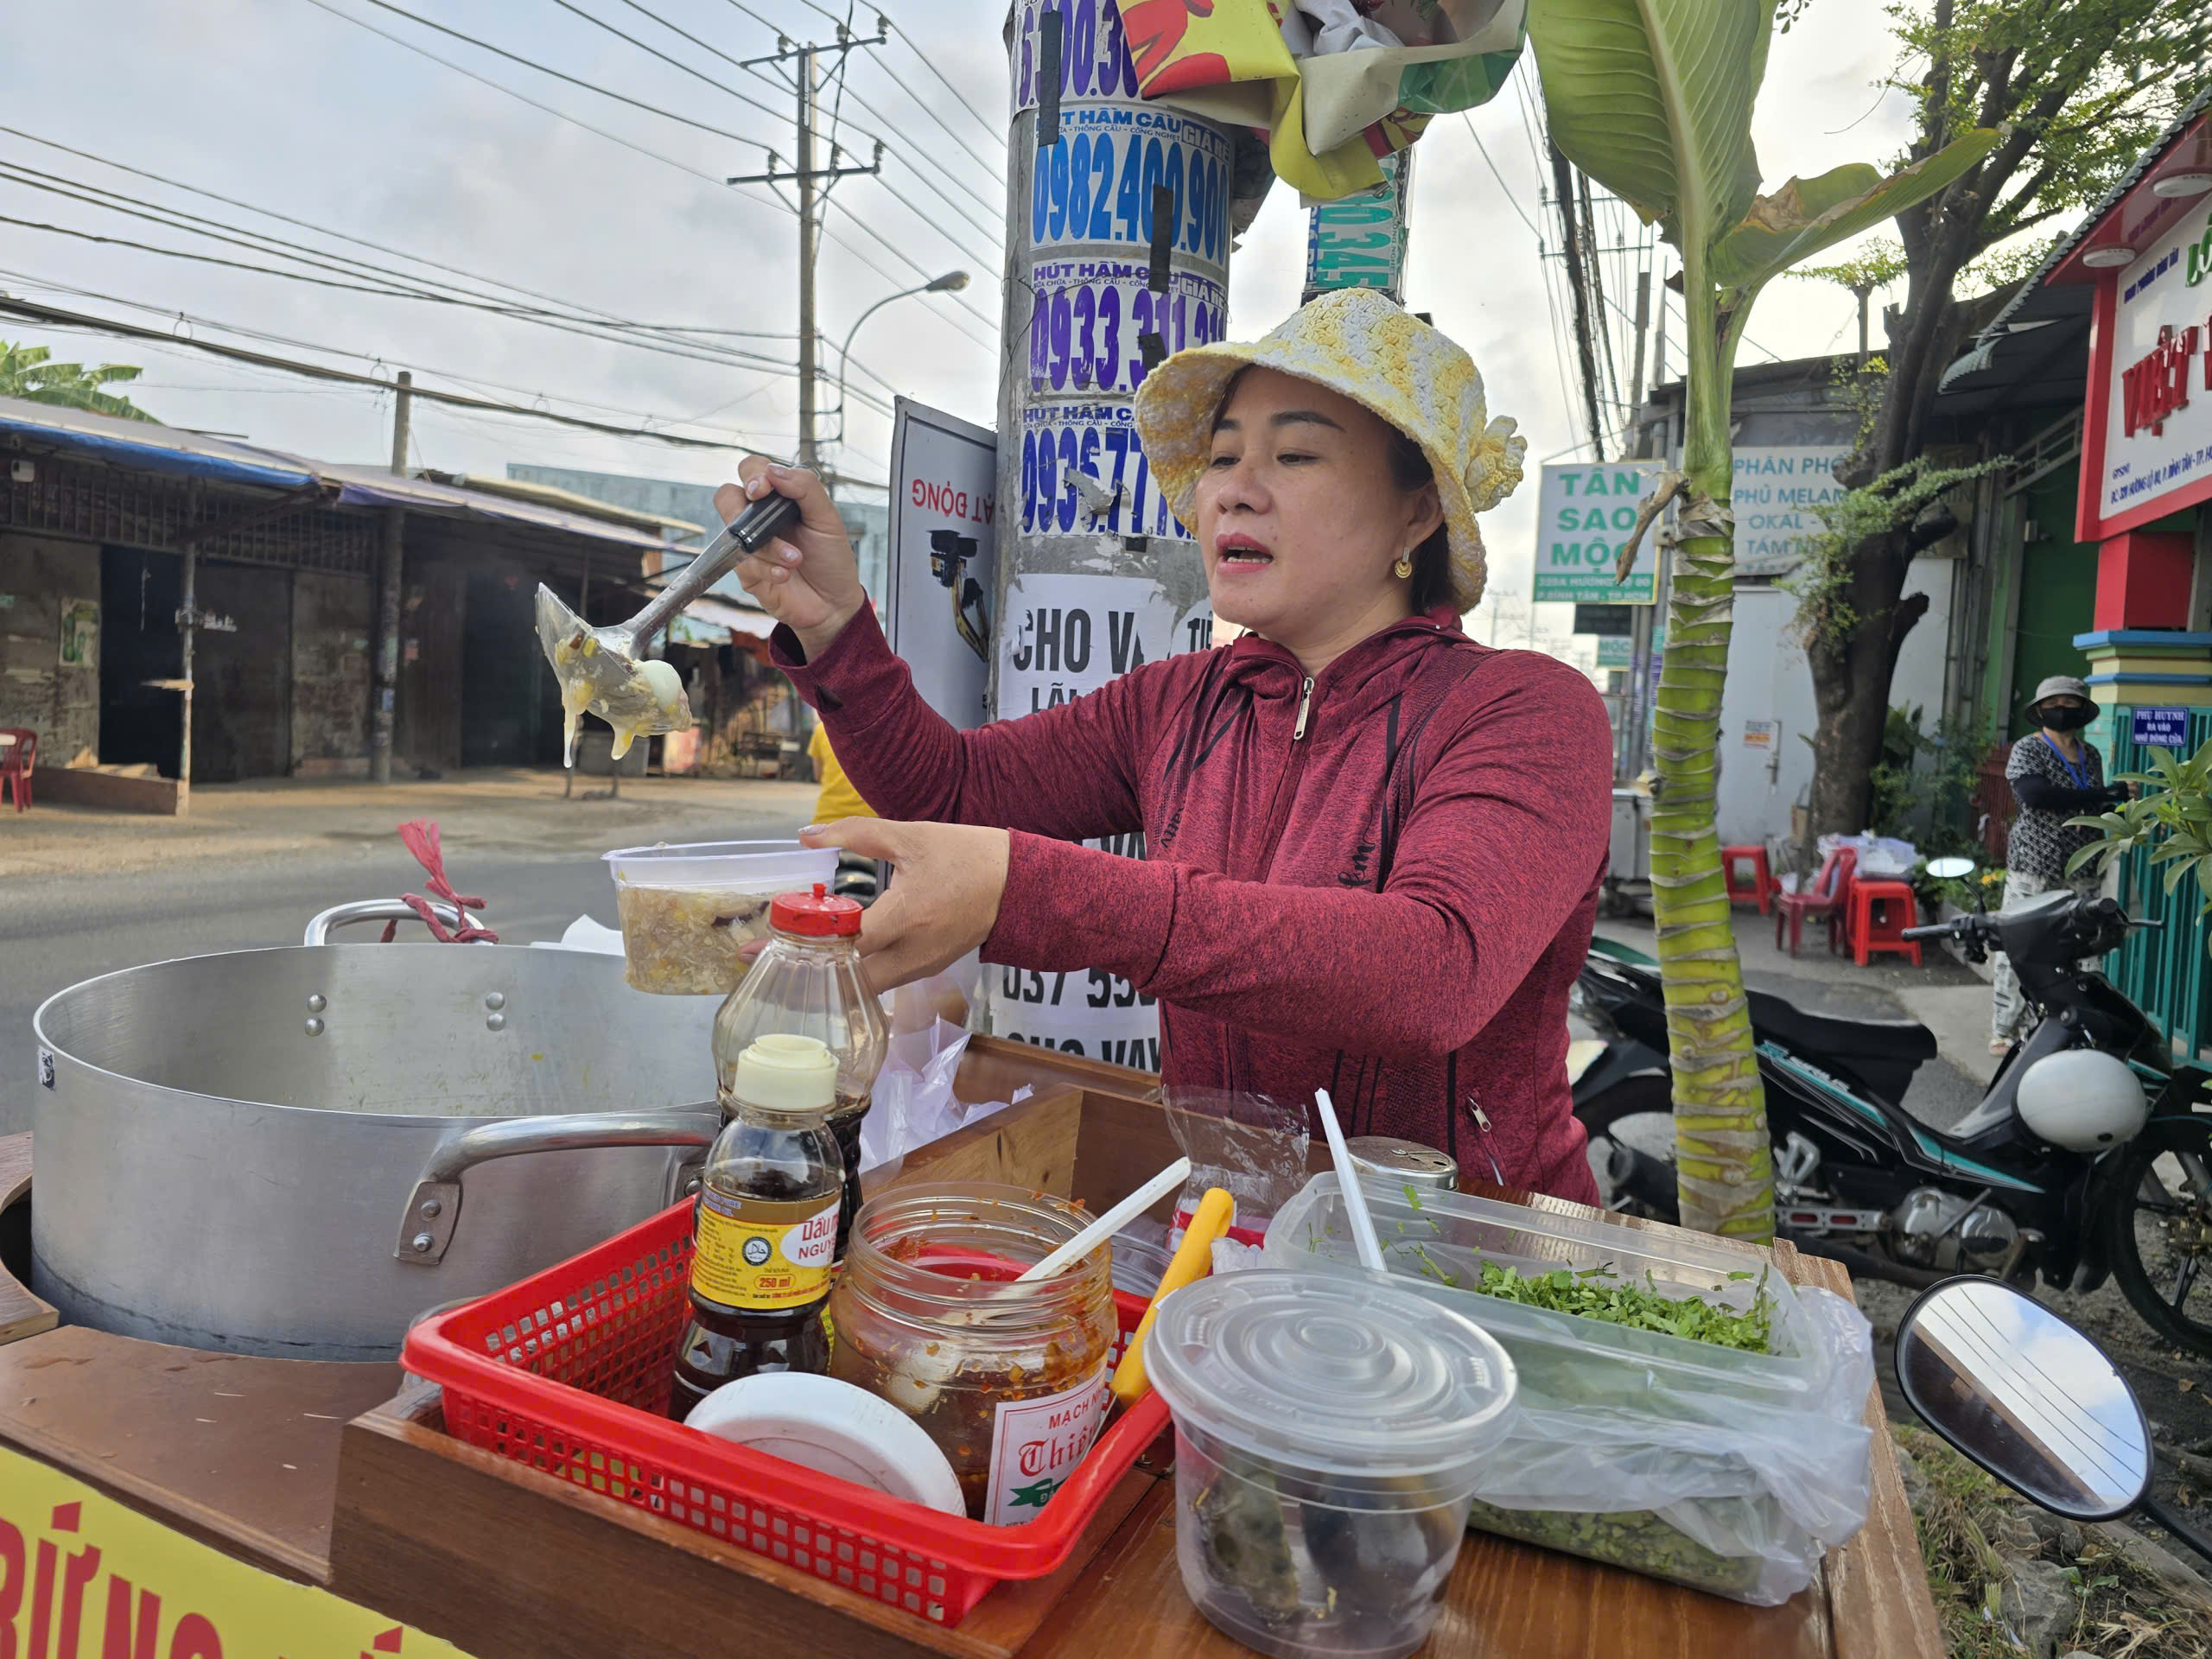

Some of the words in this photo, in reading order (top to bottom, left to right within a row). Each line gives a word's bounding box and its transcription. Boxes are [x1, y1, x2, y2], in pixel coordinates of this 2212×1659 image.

[1033, 263, 1075, 282] HÚT
[1079, 261, 1132, 277] HẦM
[1558, 467, 1640, 496] TÂN
[1556, 506, 1638, 531] SAO
[760, 1277, 777, 1288] 250
